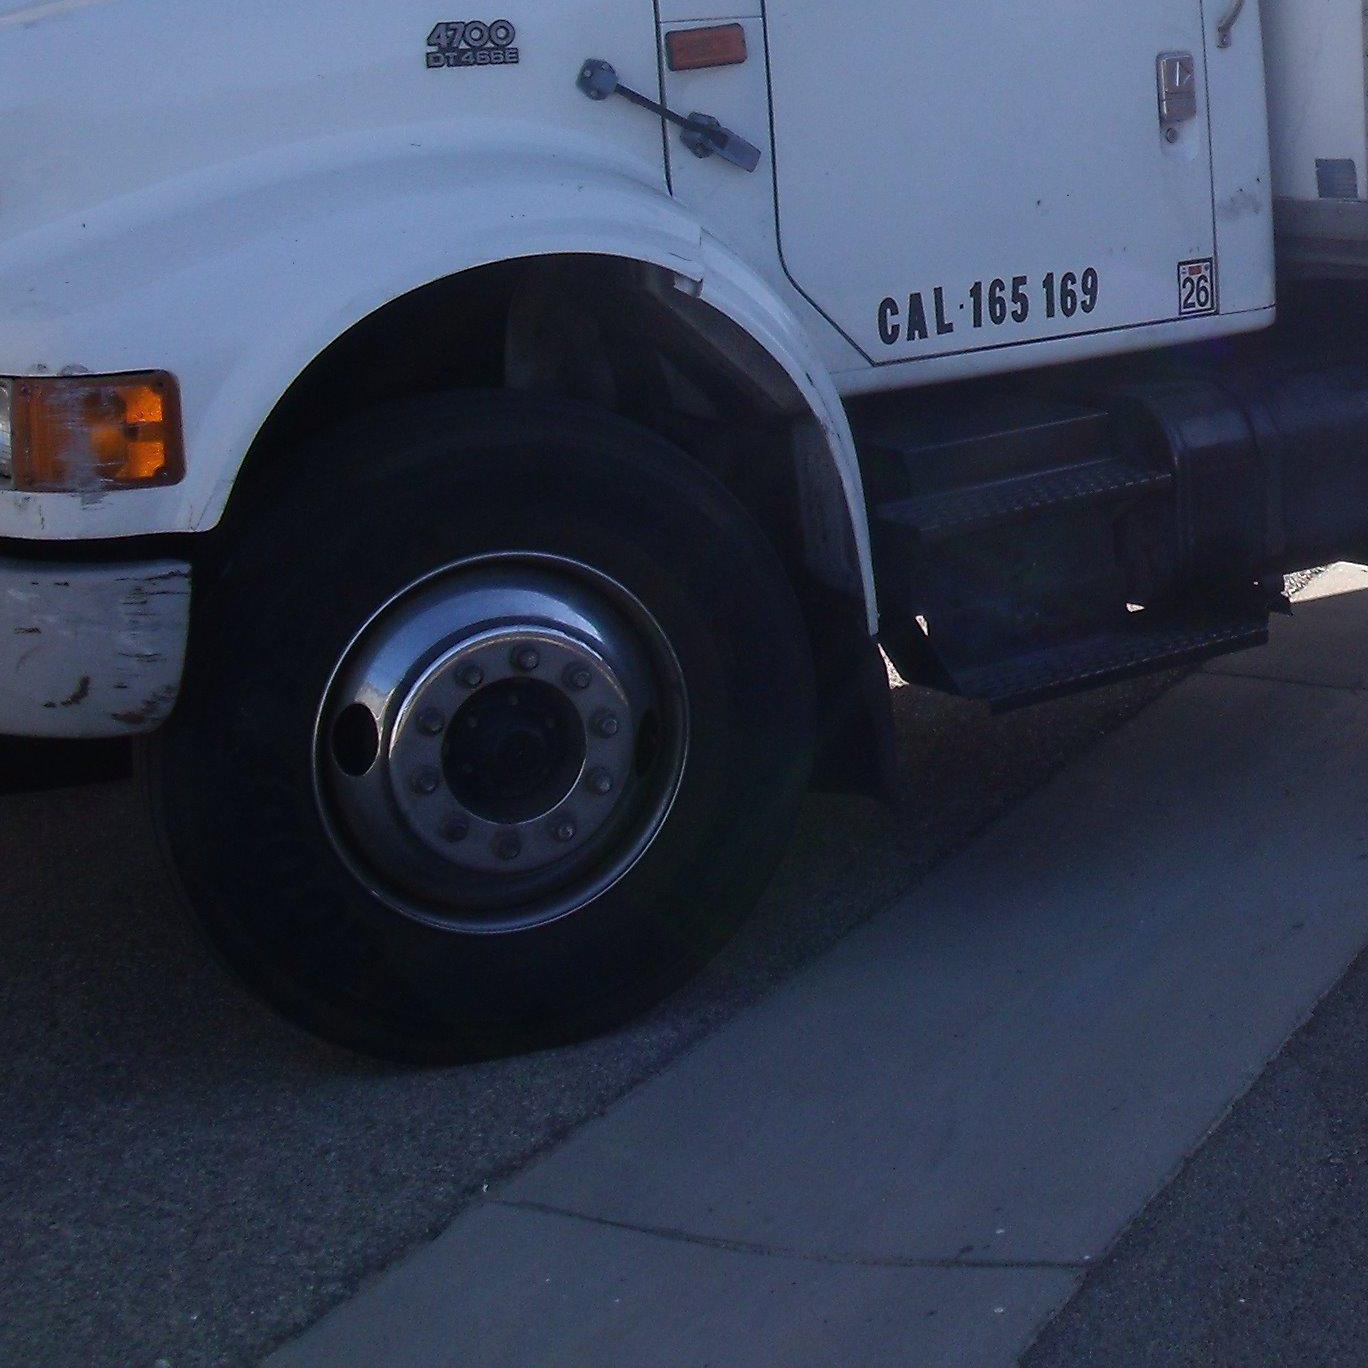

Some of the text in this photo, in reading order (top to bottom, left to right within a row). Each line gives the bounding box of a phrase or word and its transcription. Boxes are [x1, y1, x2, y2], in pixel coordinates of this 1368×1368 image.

[427, 20, 515, 49] 4700
[1042, 267, 1099, 318] 169
[1182, 274, 1210, 309] 26
